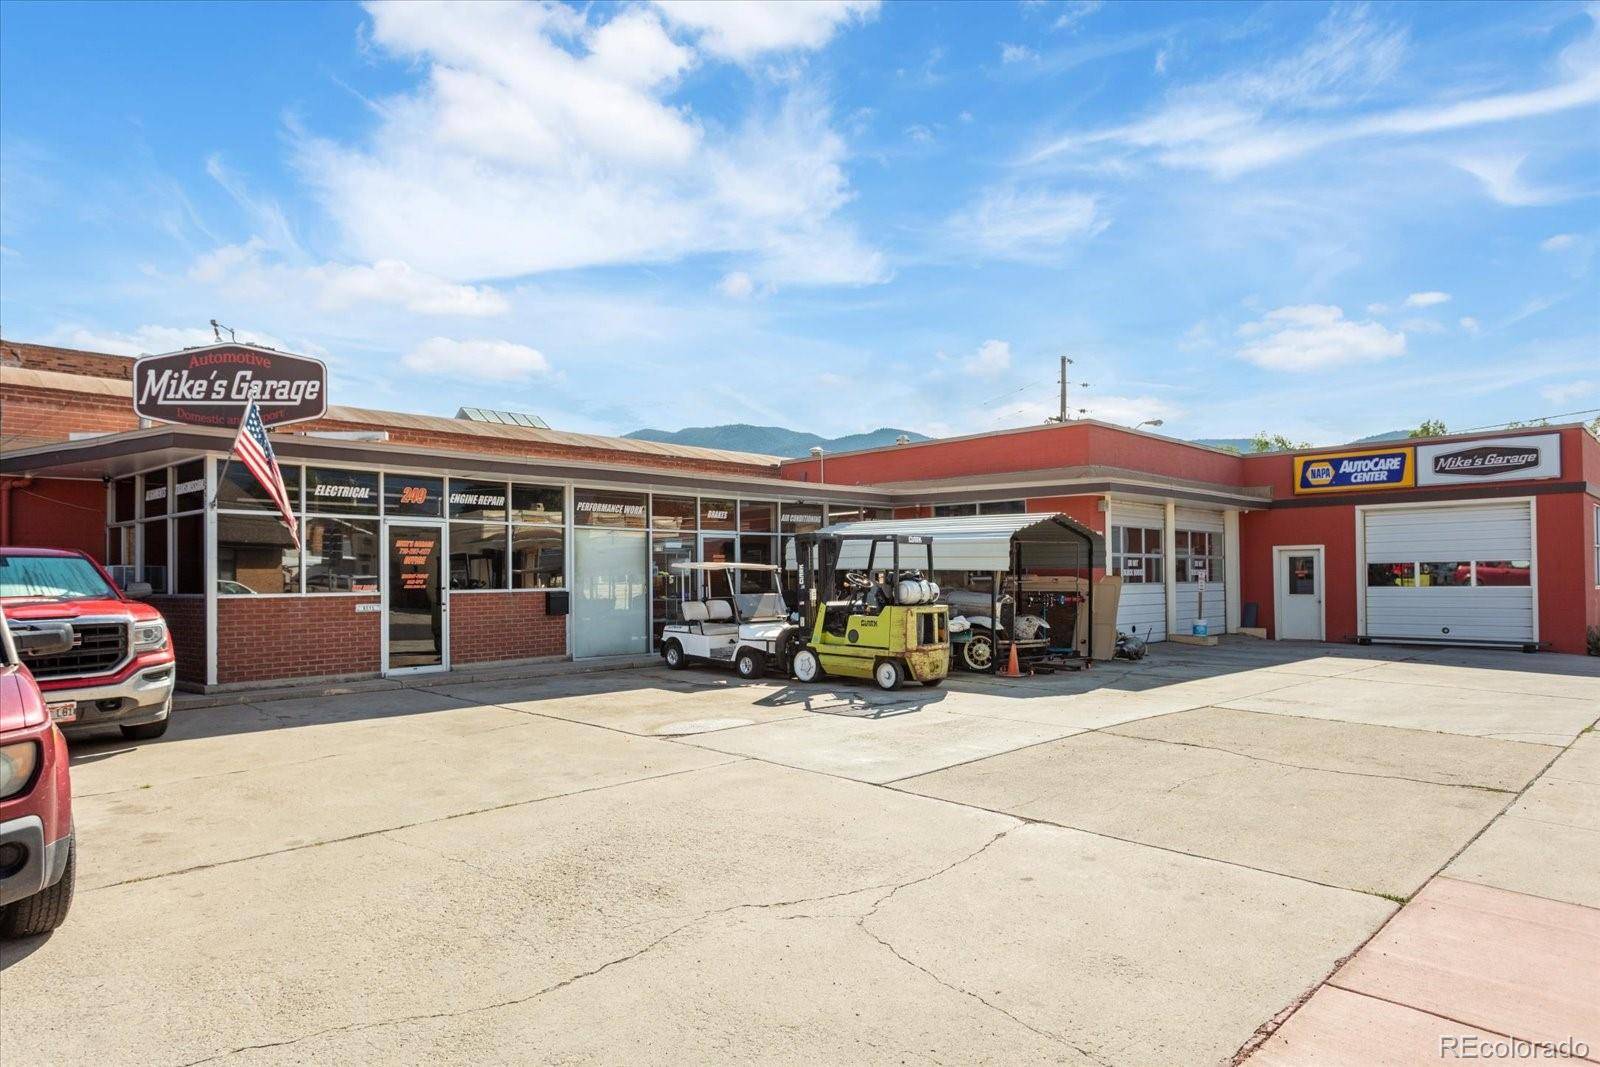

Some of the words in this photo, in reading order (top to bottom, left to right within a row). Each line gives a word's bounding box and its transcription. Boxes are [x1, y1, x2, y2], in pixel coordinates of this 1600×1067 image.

[188, 351, 272, 369] Automotive
[139, 368, 227, 406] Mike's
[230, 370, 320, 406] Garage
[176, 407, 225, 425] Domestic
[226, 414, 243, 425] an
[262, 409, 286, 424] port
[1339, 457, 1402, 474] AUTOCARE
[1435, 455, 1482, 471] Mike's
[1484, 453, 1538, 466] Garage
[1310, 467, 1331, 479] NAPA
[1350, 470, 1389, 483] CENTER
[314, 485, 371, 499] ELECTRICAL
[449, 493, 478, 505] ENGINE
[478, 495, 506, 506] REPAIR
[576, 501, 624, 514] PERFORMANCE
[623, 505, 644, 515] WORK
[707, 510, 729, 520] BRAKES
